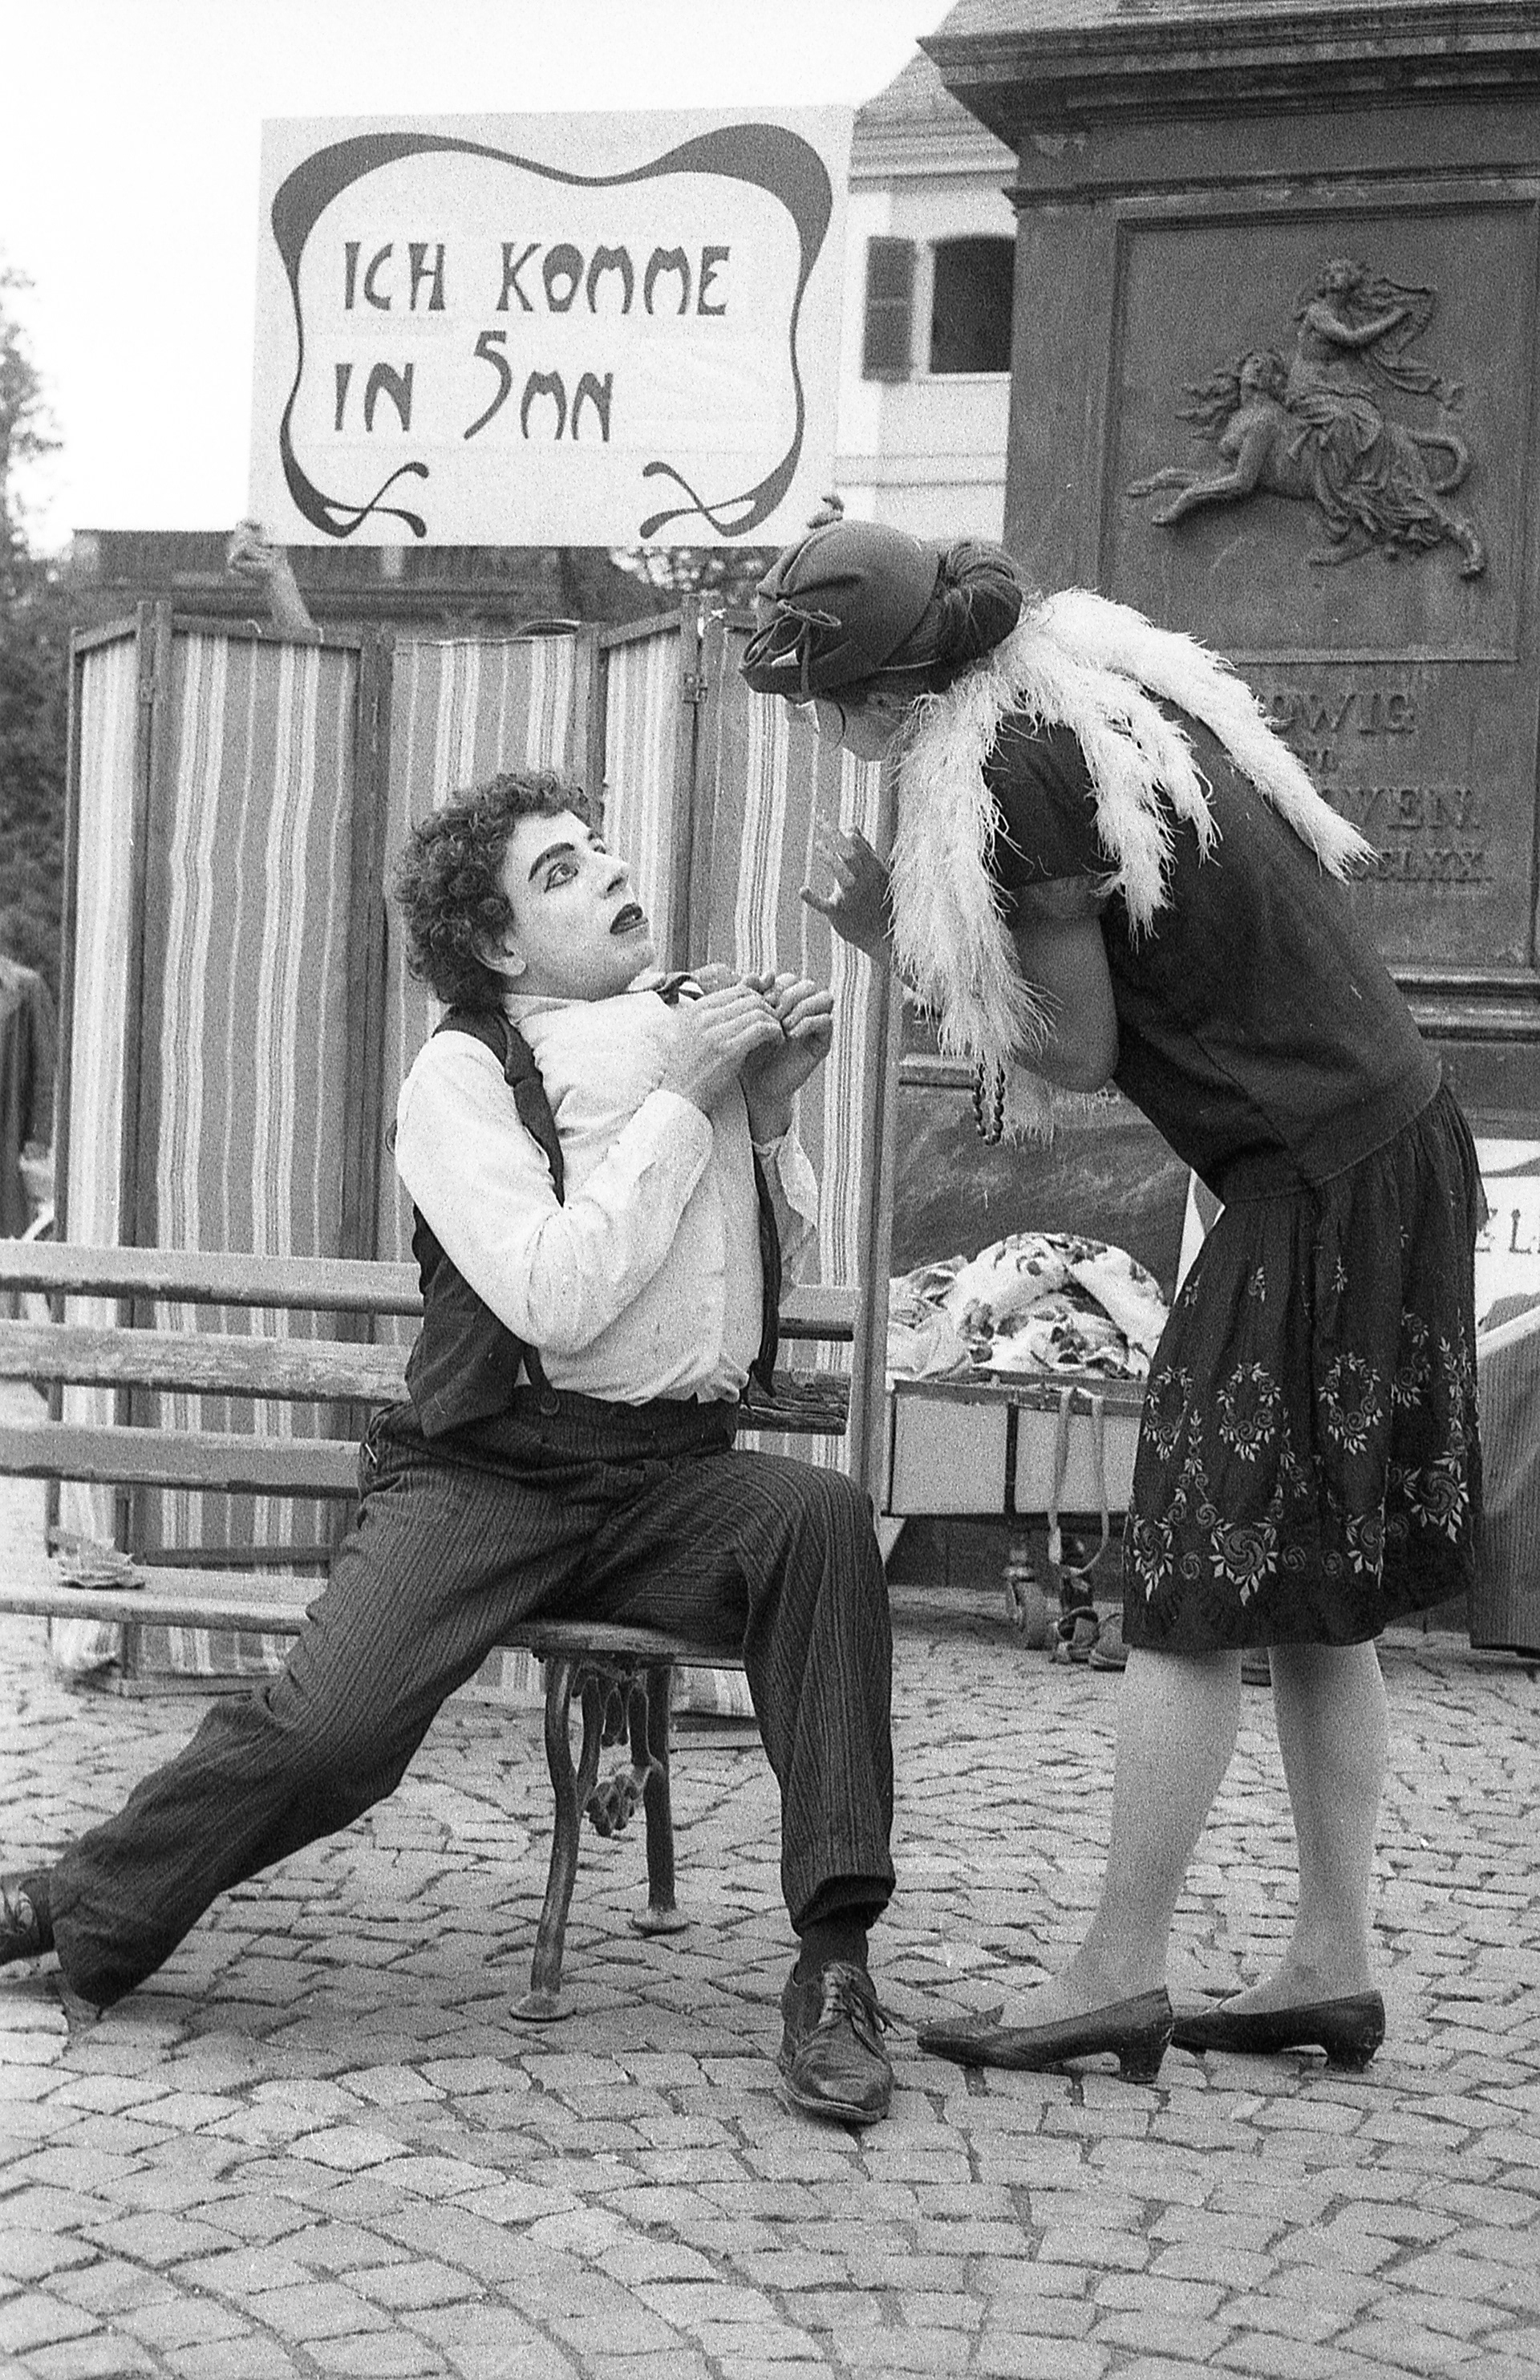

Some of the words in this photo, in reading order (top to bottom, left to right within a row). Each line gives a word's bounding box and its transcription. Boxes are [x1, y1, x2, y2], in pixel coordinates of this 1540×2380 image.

[346, 243, 444, 310] ICH
[497, 244, 729, 314] KOMME
[336, 363, 413, 431] IN
[464, 331, 512, 439] 5
[521, 371, 612, 441] MN
